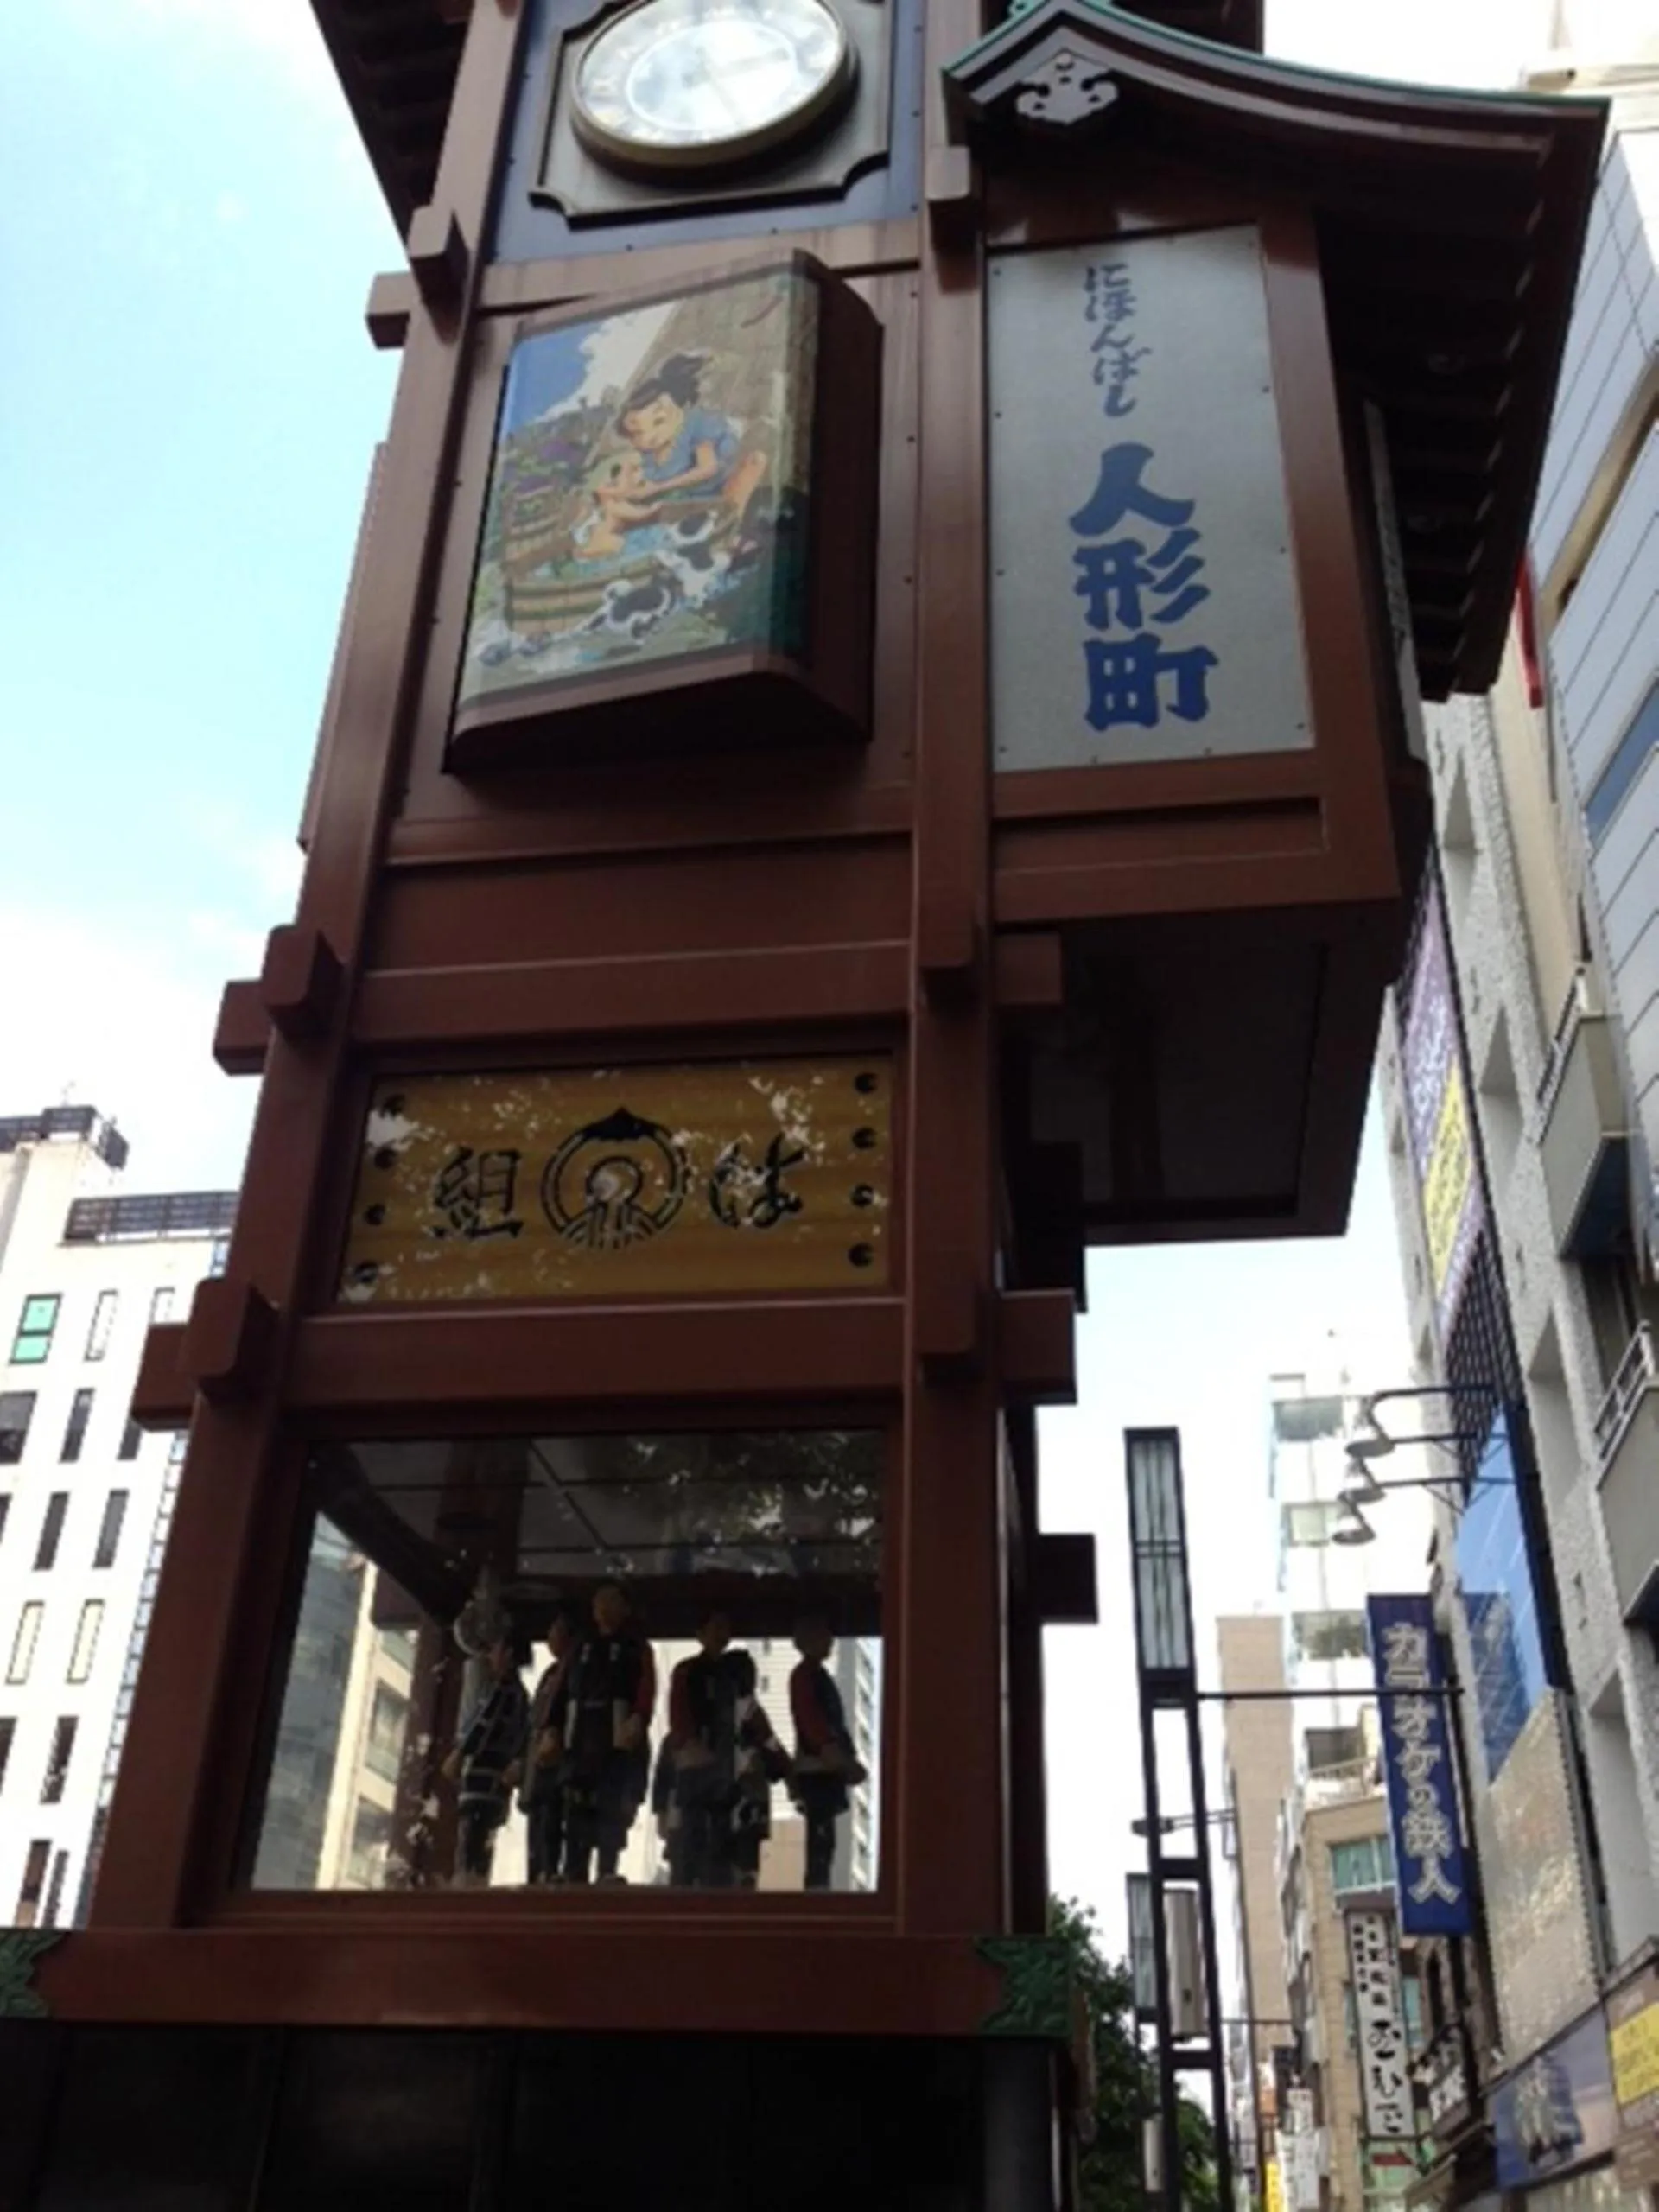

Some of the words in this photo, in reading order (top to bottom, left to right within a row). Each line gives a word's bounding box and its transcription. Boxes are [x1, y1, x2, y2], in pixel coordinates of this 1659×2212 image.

[1084, 263, 1153, 418] にほんばし
[1070, 442, 1218, 732] 人形町
[1382, 1621, 1460, 1904] カラオケの鉄人
